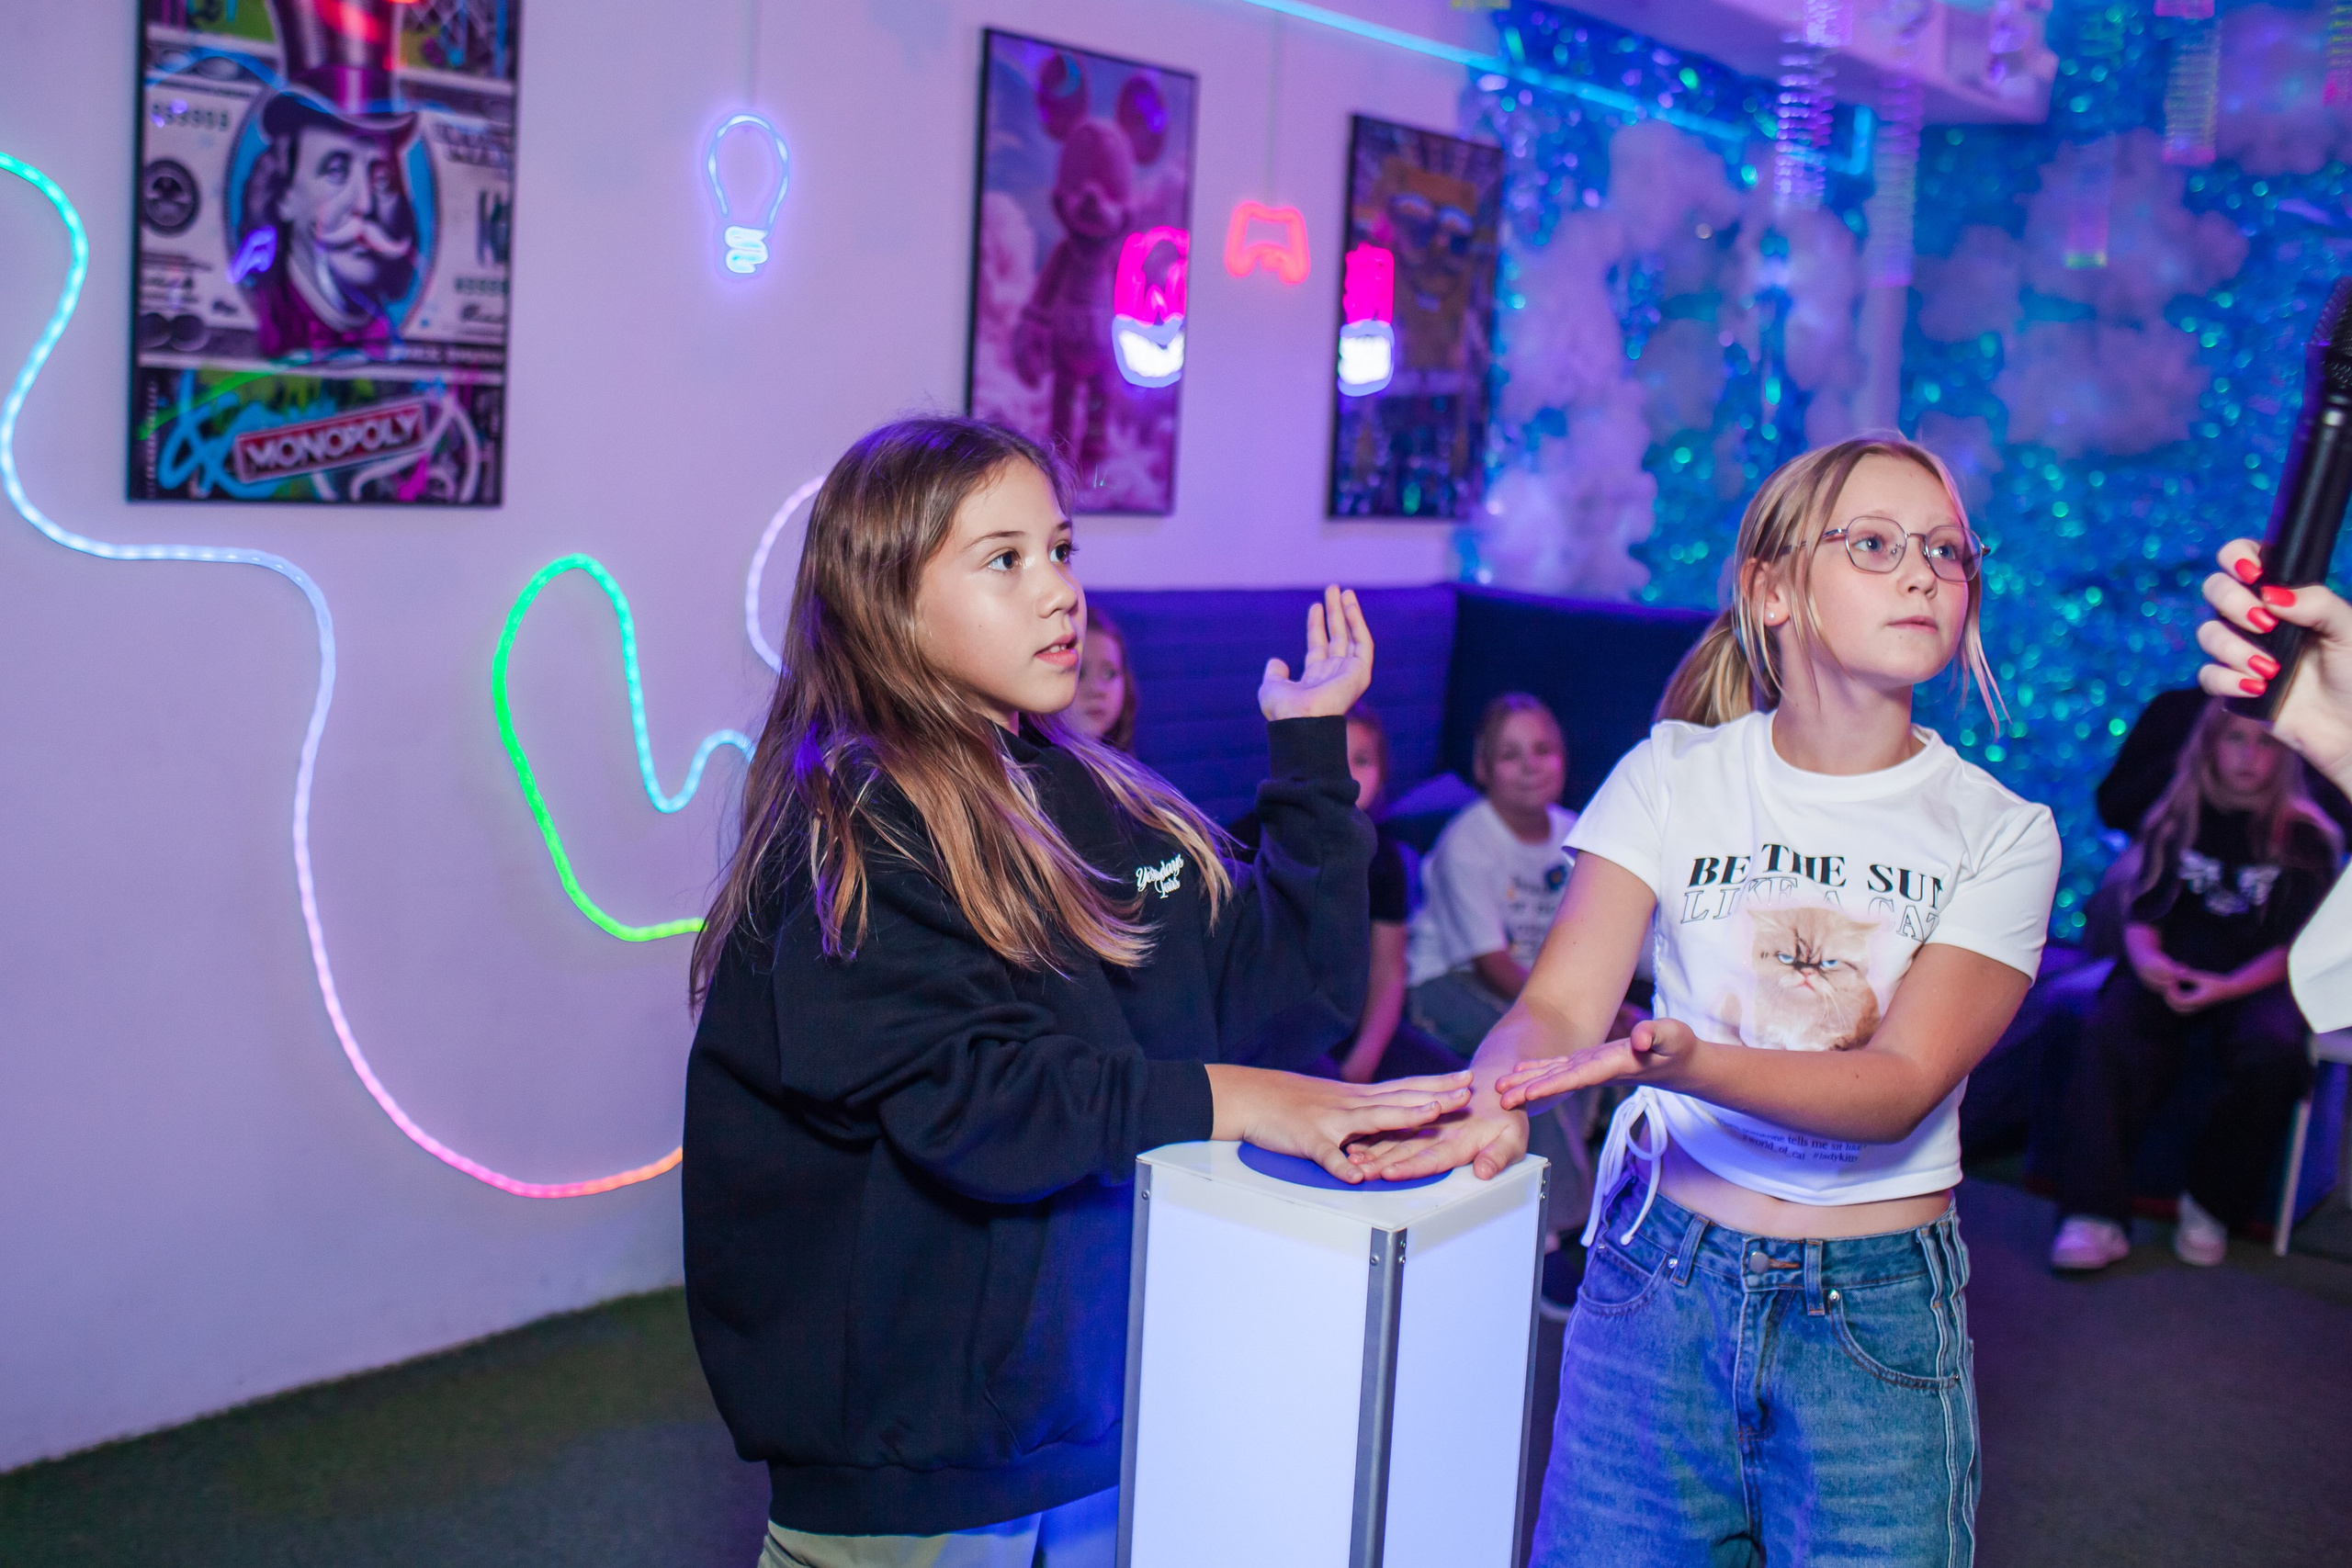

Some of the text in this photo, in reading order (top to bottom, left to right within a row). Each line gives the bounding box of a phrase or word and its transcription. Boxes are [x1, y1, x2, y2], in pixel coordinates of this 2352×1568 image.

[245, 413, 421, 467] MONOPOLY
[1687, 855, 1751, 888] BE
[1761, 843, 1847, 888] THE
[1787, 1135, 1809, 1147] tells
[1812, 1141, 1829, 1150] me
